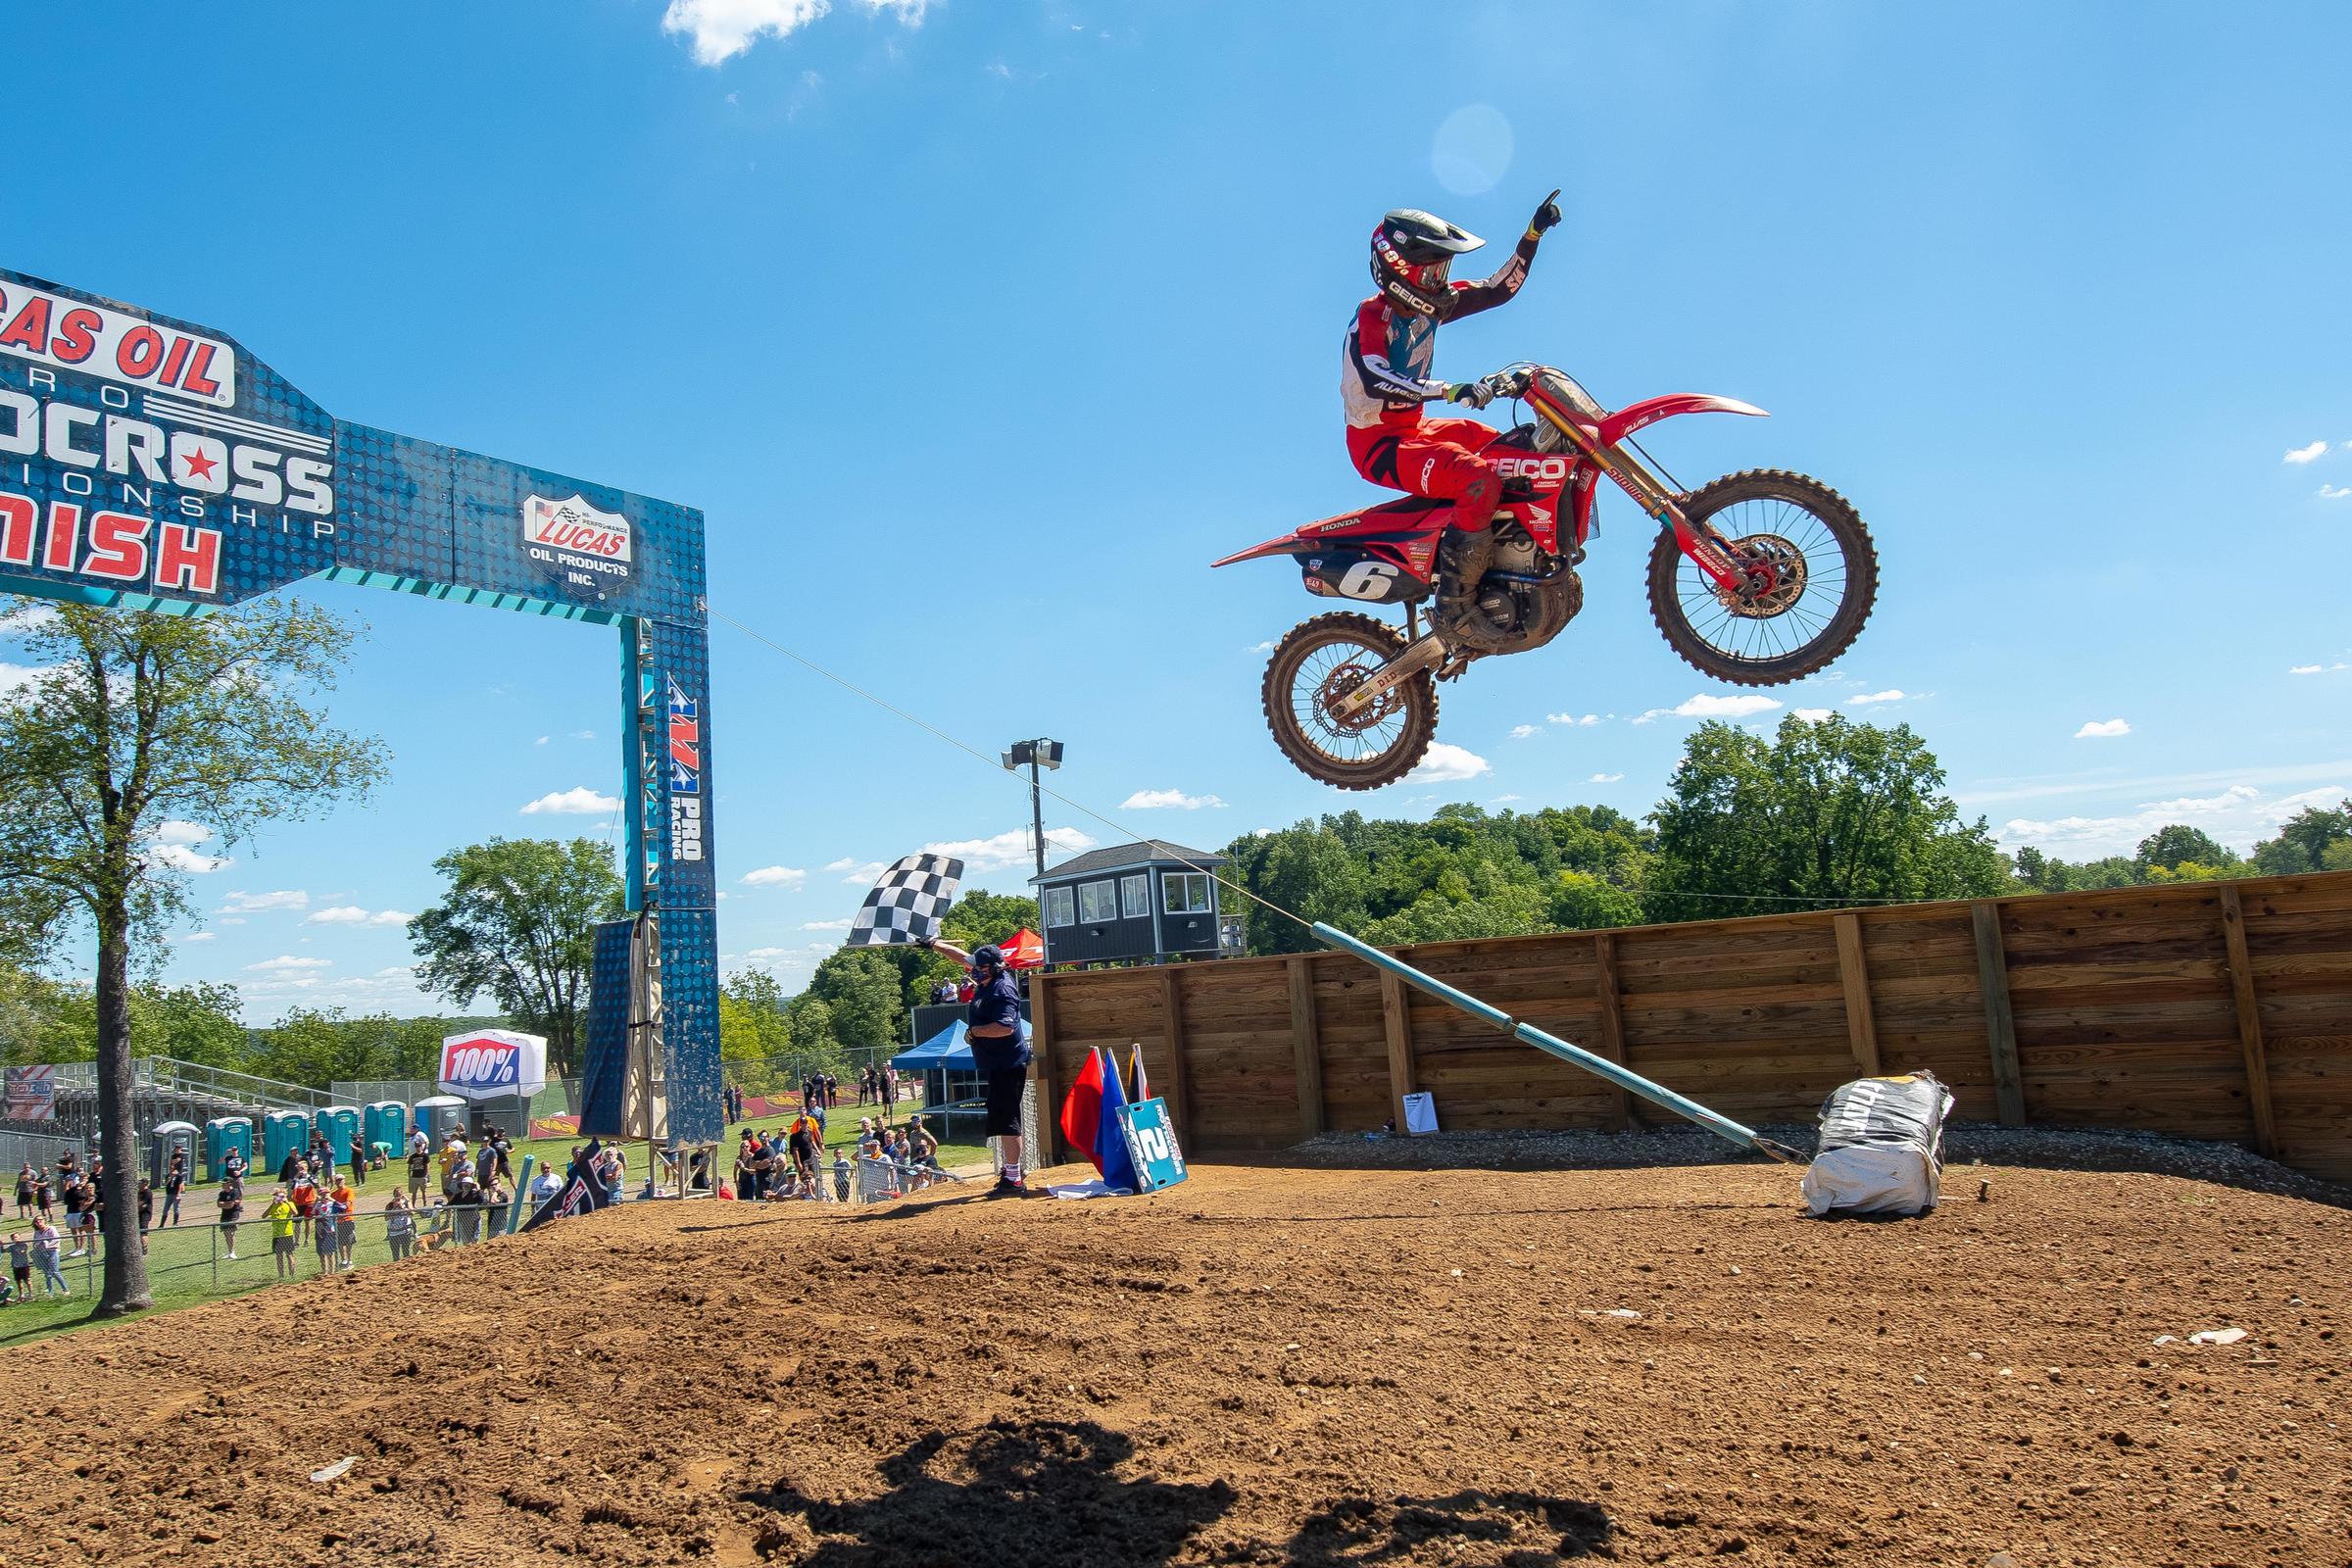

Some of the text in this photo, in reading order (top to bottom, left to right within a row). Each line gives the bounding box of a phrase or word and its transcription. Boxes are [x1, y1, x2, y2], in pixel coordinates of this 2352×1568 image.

[1390, 281, 1435, 315] GEICO
[0, 287, 220, 398] AS OIL
[1421, 458, 1436, 495] EICO
[1607, 465, 1646, 502] SHOWA
[536, 520, 626, 557] LUCAS
[1320, 517, 1361, 532] HONDA
[529, 546, 628, 577] OIL PRODUCTS
[567, 572, 596, 587] INC.
[1338, 561, 1399, 600] 6
[670, 796, 683, 860] RACING
[681, 797, 703, 861] PRO
[451, 1048, 514, 1083] 100%
[1138, 1126, 1169, 1163] 2
